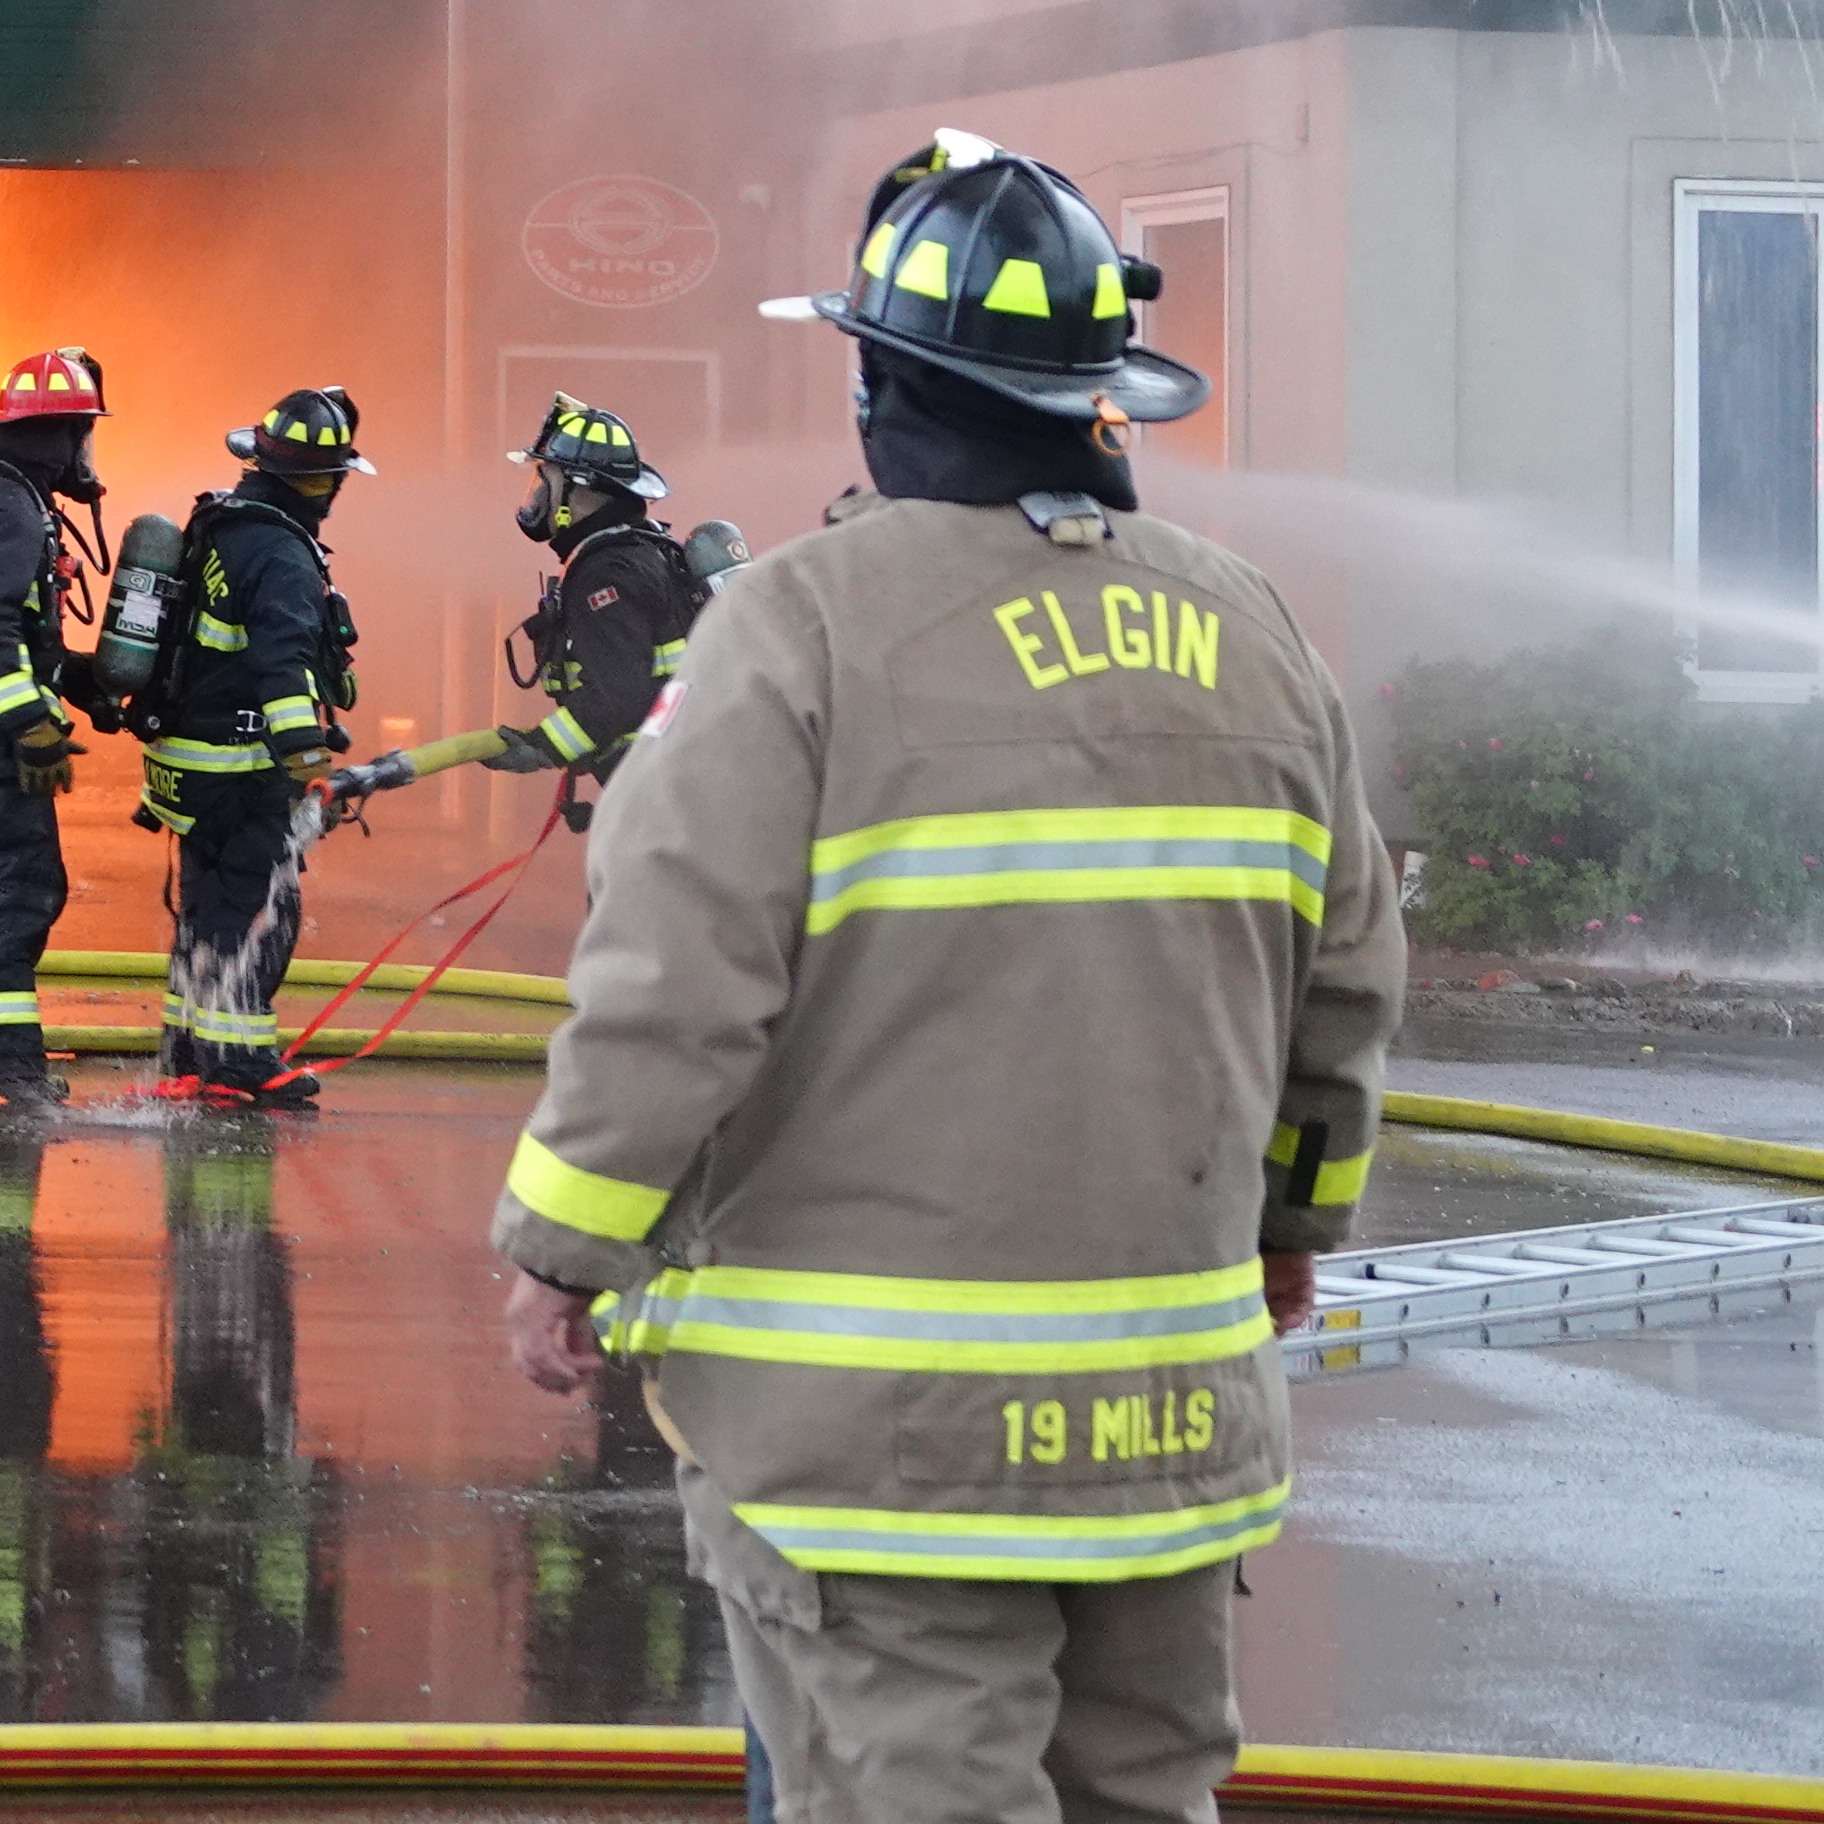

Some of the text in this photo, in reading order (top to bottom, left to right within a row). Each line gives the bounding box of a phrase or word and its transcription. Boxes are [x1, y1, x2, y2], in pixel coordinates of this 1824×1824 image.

[568, 257, 675, 277] HINO
[993, 584, 1221, 690] ELGIN
[1003, 1389, 1216, 1465] 19 MILLS
